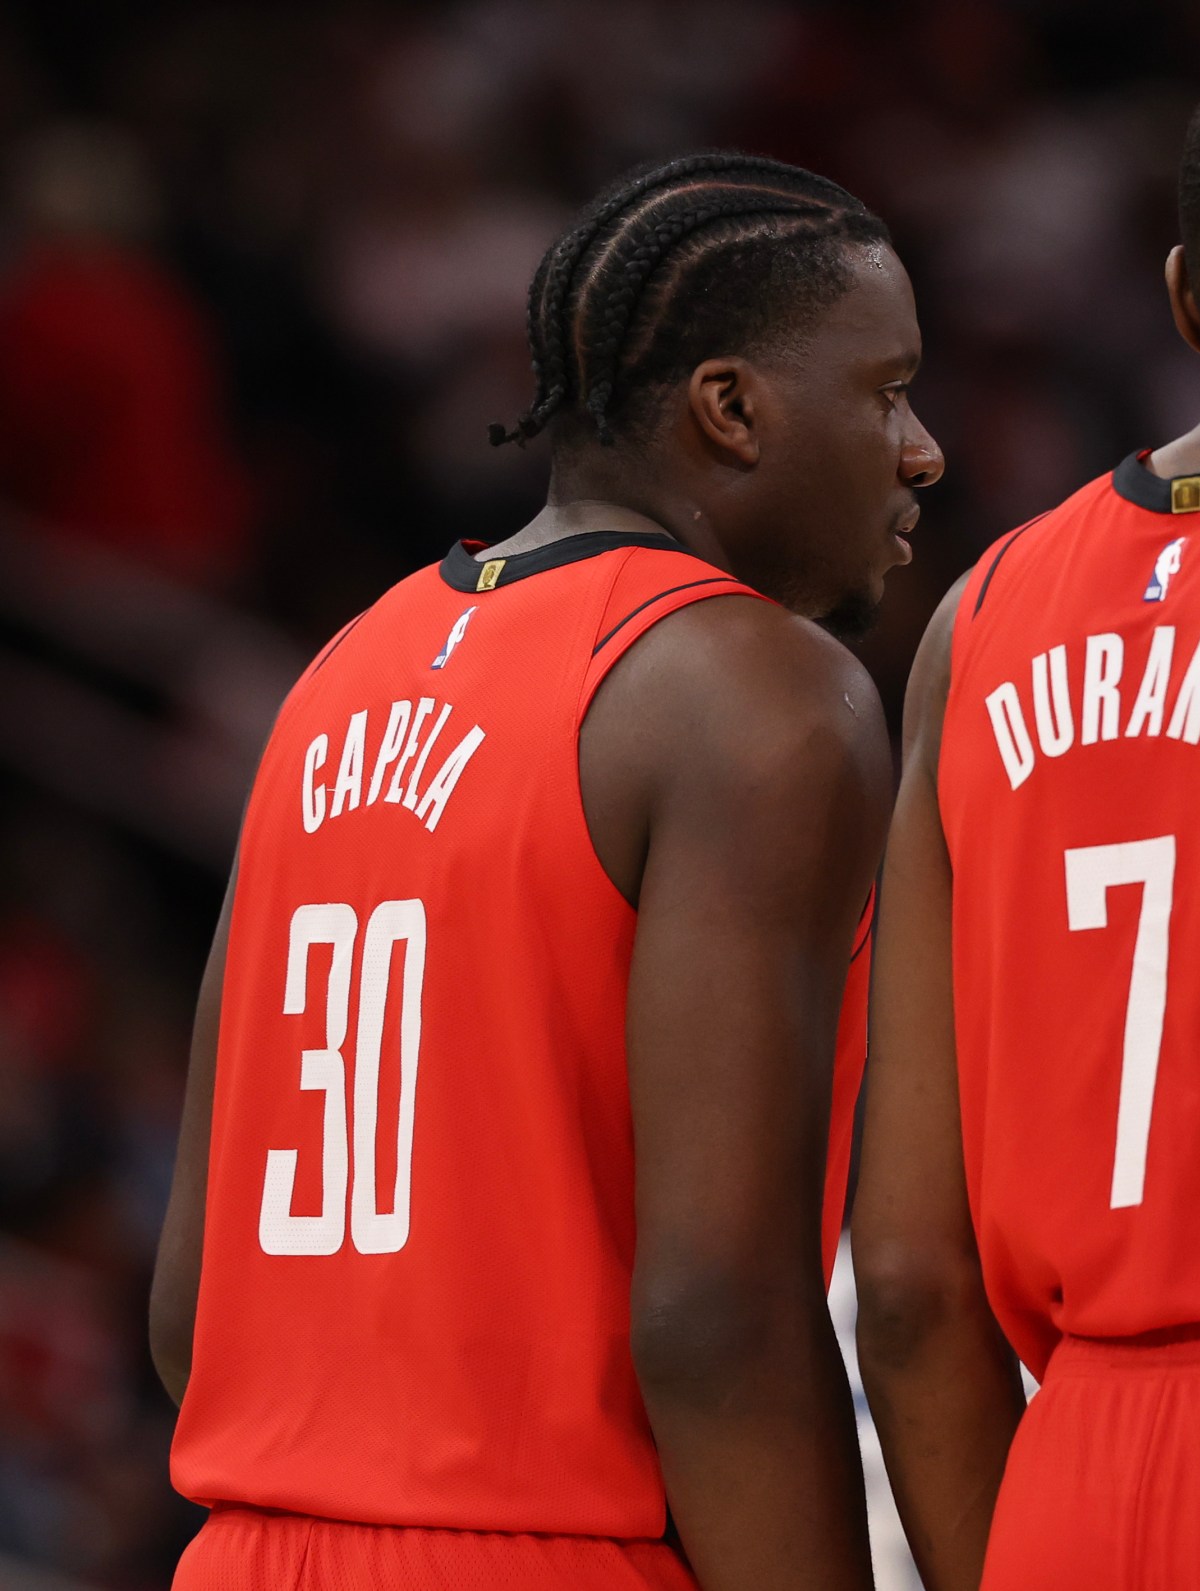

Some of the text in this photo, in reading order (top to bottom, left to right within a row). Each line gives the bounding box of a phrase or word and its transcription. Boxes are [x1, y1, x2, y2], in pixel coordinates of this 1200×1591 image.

[302, 697, 487, 834] CAPELA
[258, 898, 427, 1256] 30
[1064, 835, 1176, 1209] 7
